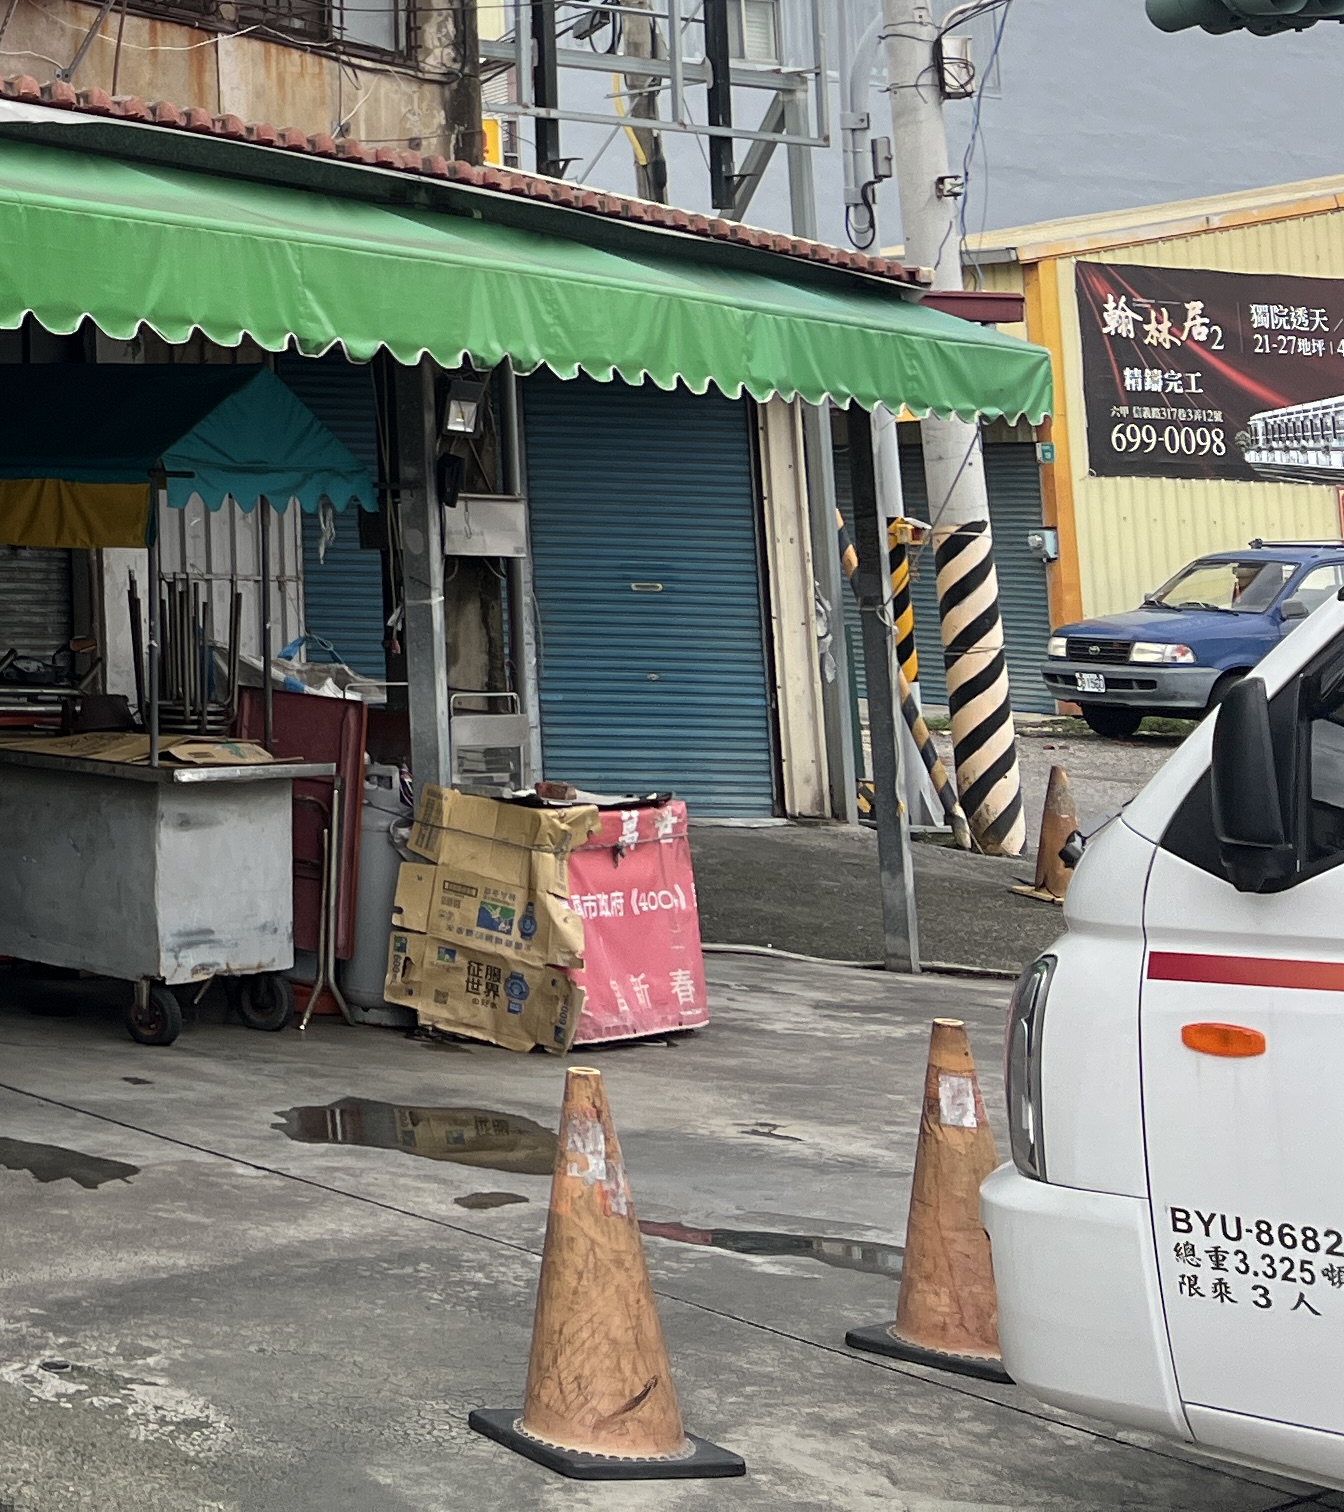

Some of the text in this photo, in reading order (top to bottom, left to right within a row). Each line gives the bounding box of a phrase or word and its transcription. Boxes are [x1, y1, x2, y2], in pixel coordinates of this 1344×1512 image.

[1250, 304, 1330, 332] 獨院透天
[1111, 423, 1226, 456] 699-0098
[467, 960, 502, 984] 征服
[465, 977, 500, 1000] 世界
[1170, 1206, 1344, 1257] BYU-8682
